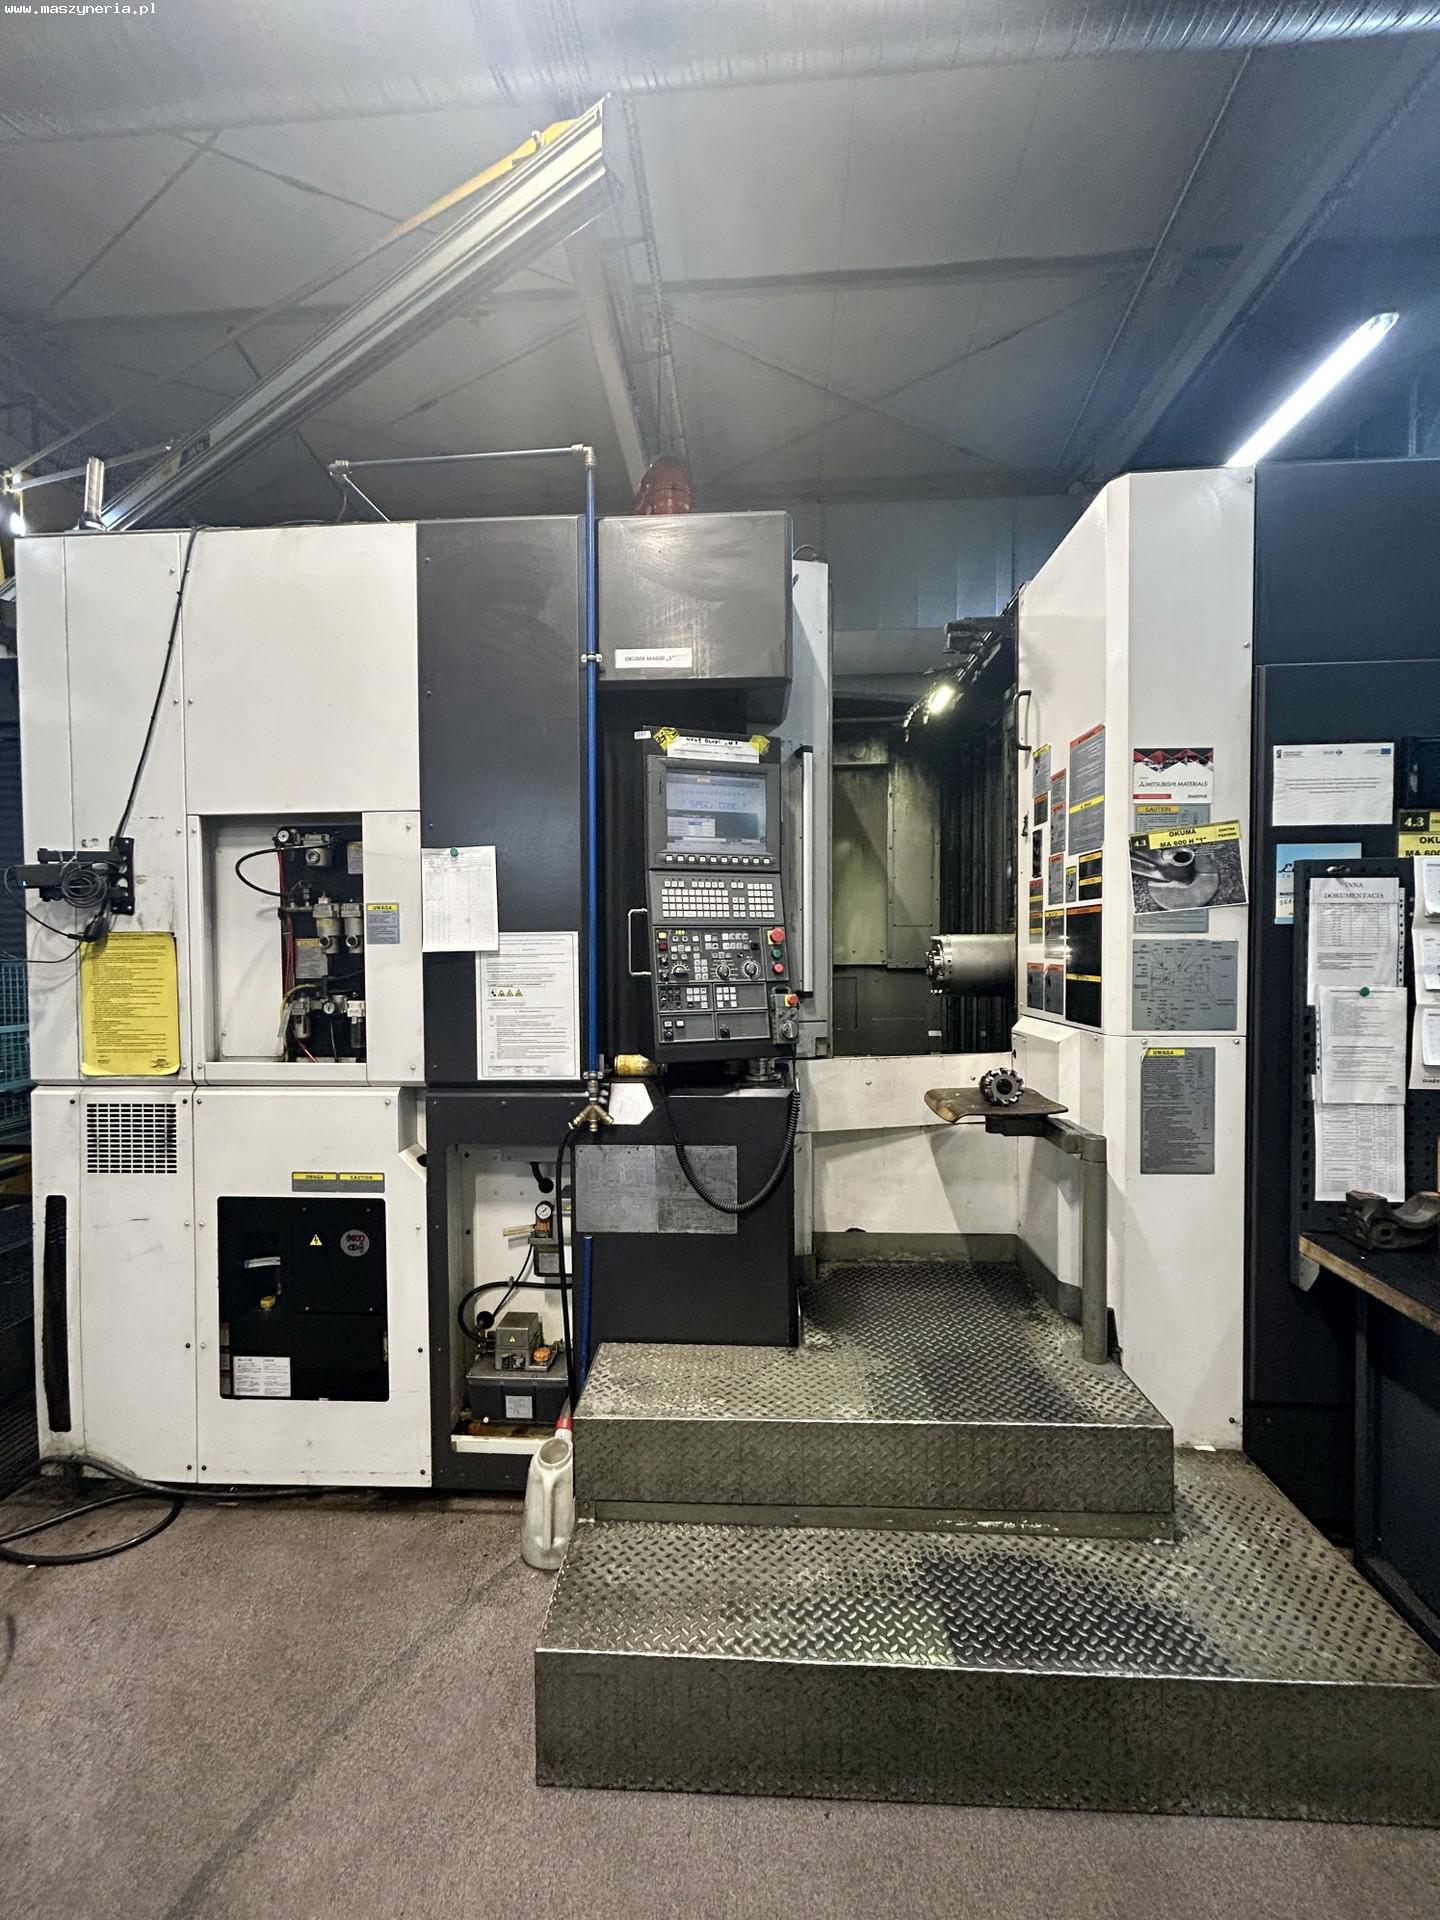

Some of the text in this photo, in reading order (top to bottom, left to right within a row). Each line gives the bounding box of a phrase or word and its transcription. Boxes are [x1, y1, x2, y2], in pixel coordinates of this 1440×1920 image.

[1404, 816, 1425, 827] 4.3
[1168, 828, 1197, 838] OKUMA
[1134, 839, 1148, 847] 4.3
[1173, 838, 1188, 847] 600
